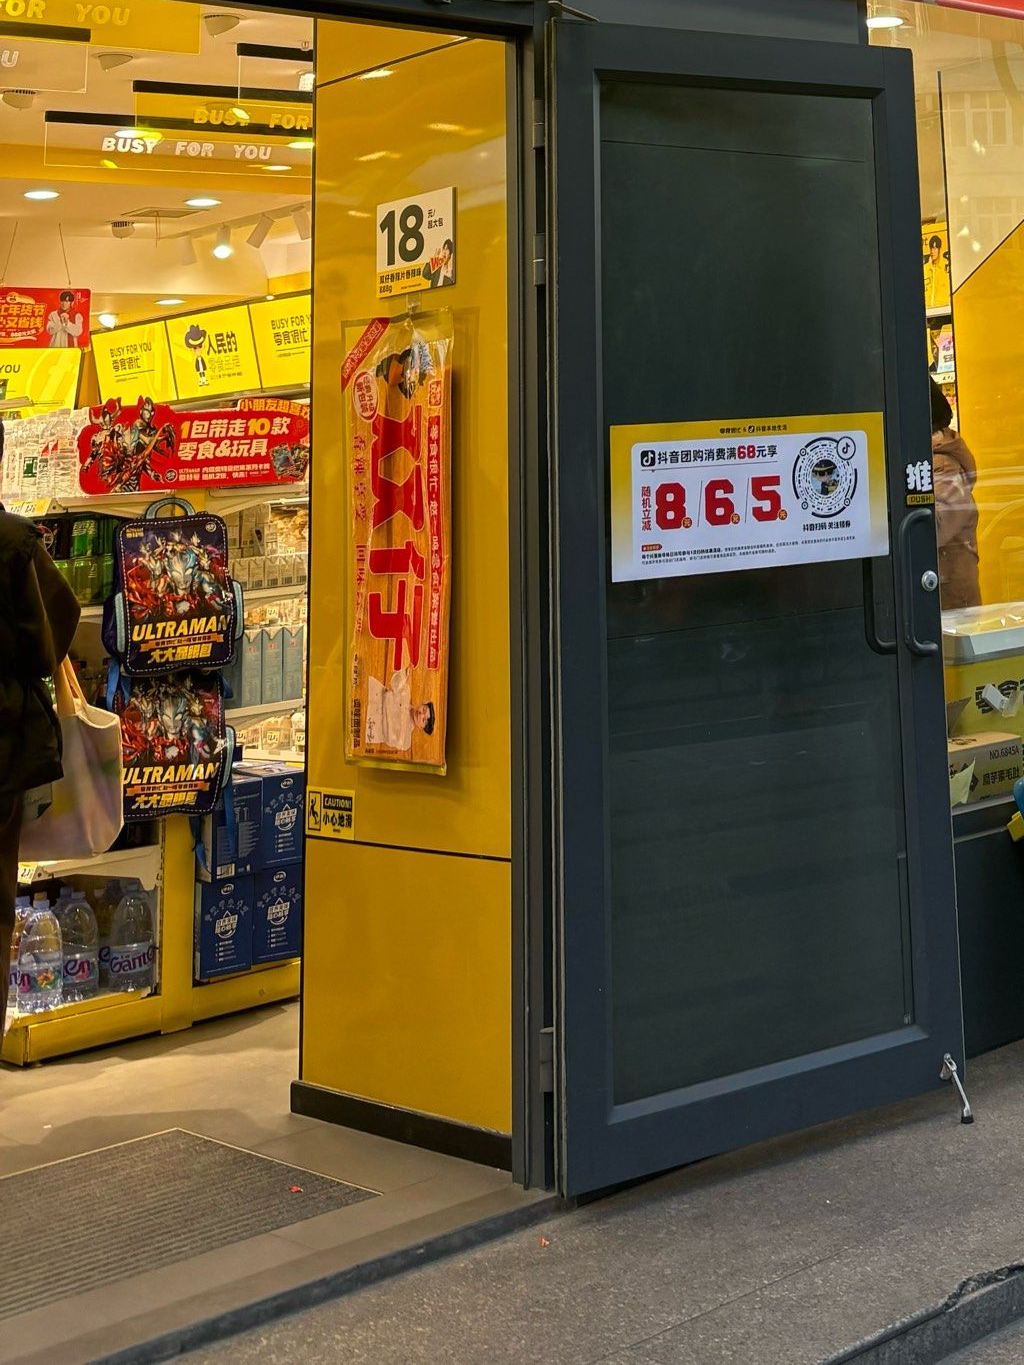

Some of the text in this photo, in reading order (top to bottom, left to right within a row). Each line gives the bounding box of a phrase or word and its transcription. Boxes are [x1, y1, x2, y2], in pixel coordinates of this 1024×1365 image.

[76, 3, 131, 27] YOU
[269, 113, 311, 131] FOR
[102, 136, 272, 161] BUSY FOR YOU
[379, 204, 425, 267] 18
[271, 315, 305, 330] BUSY FOR
[206, 330, 238, 356] 人民的
[273, 327, 309, 347] 零食很忙
[109, 341, 153, 359] BUSY FOR YOU
[112, 354, 142, 373] 零食很忙
[180, 416, 291, 440] 1包带走10款
[177, 438, 269, 462] 零食&玩具
[906, 460, 933, 492] 推
[641, 485, 652, 532] 随机立减
[368, 404, 427, 671] 双仔
[131, 614, 232, 641] ULTRAMAN
[122, 762, 220, 785] ULTRAMAN
[324, 796, 352, 809] CAUTION!
[322, 809, 353, 829] 小心地滑
